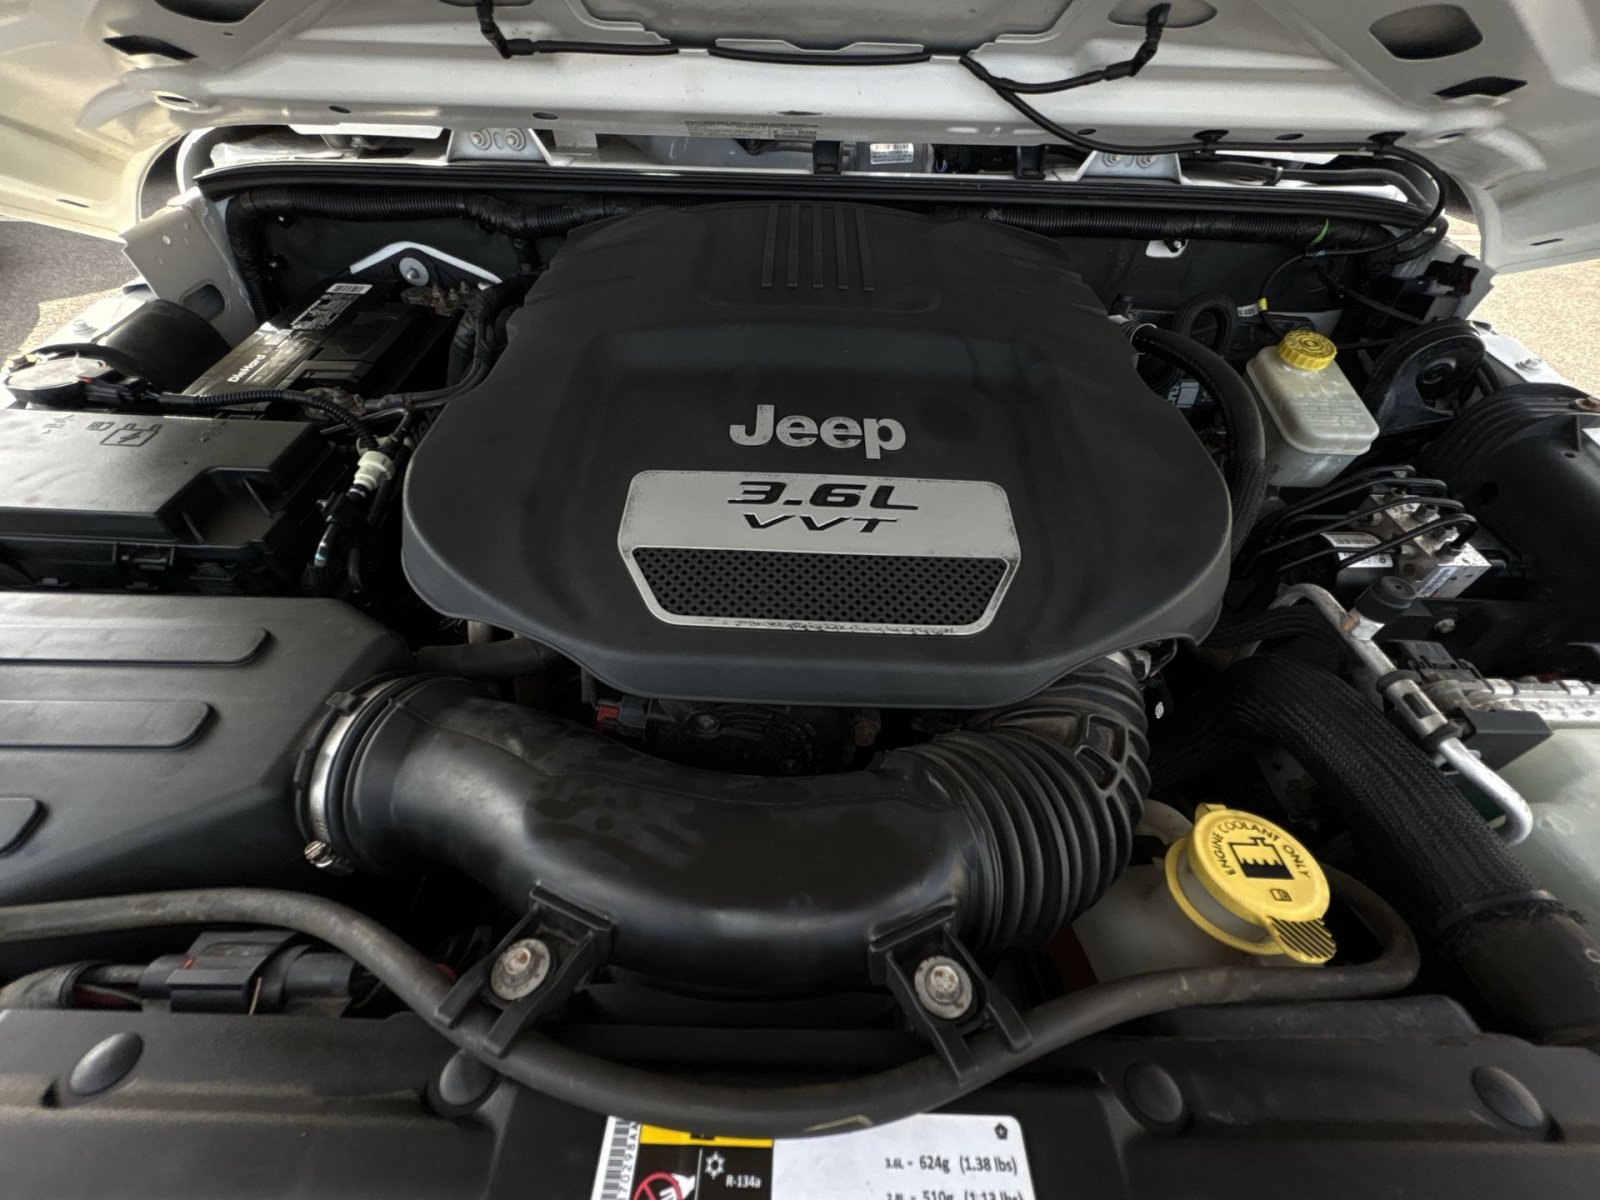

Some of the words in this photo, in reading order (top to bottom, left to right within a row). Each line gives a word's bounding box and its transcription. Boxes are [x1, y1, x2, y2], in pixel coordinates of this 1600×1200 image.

[729, 404, 906, 460] Jeep
[727, 481, 919, 511] 3.6L
[743, 513, 900, 533] VVT
[1217, 821, 1280, 841] COOLANT
[1211, 832, 1236, 876] ENGINE
[1282, 844, 1312, 879] ONLY
[615, 1121, 639, 1200] 70298AA
[919, 1155, 951, 1174] 624g
[959, 1155, 992, 1175] (1.38
[994, 1156, 1018, 1176] lbs)
[725, 1174, 762, 1189] R-134a
